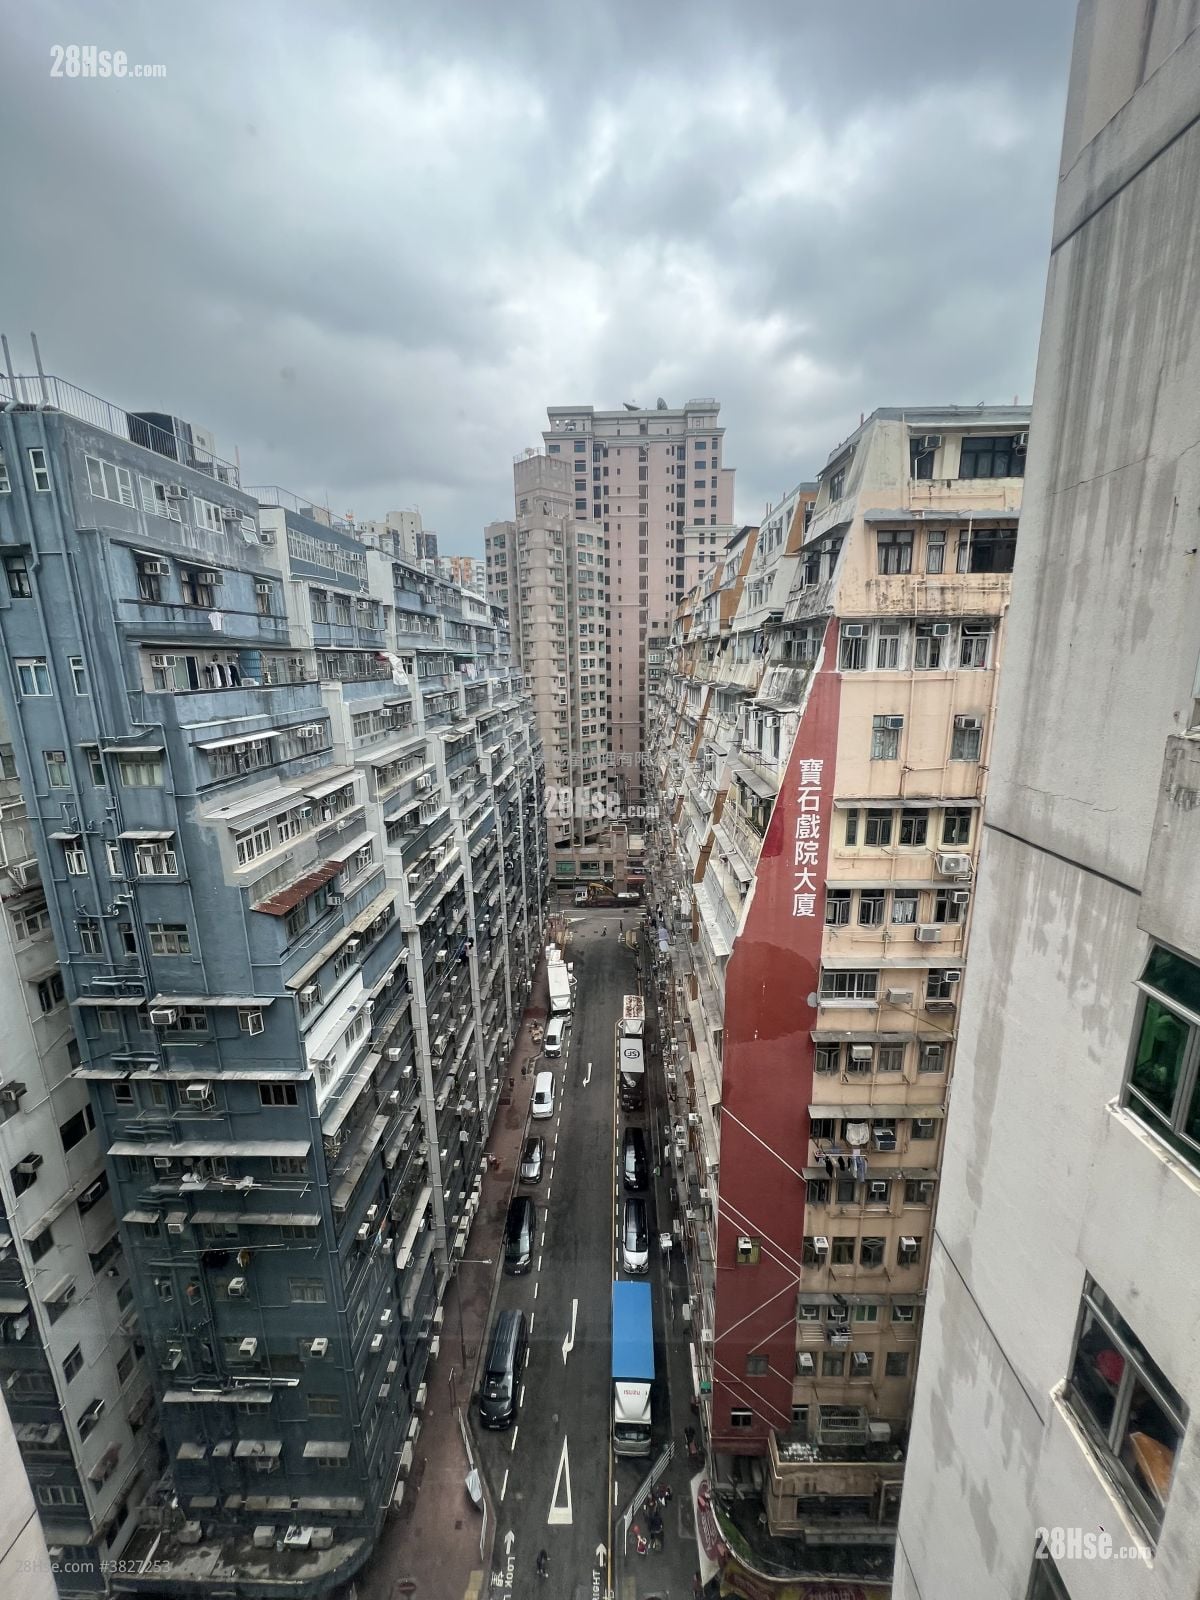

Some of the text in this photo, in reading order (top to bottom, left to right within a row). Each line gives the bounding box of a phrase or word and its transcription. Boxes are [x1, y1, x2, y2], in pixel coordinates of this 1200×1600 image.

[792, 758, 824, 917] 寶石戲院大廈
[504, 1556, 516, 1588] LOOK
